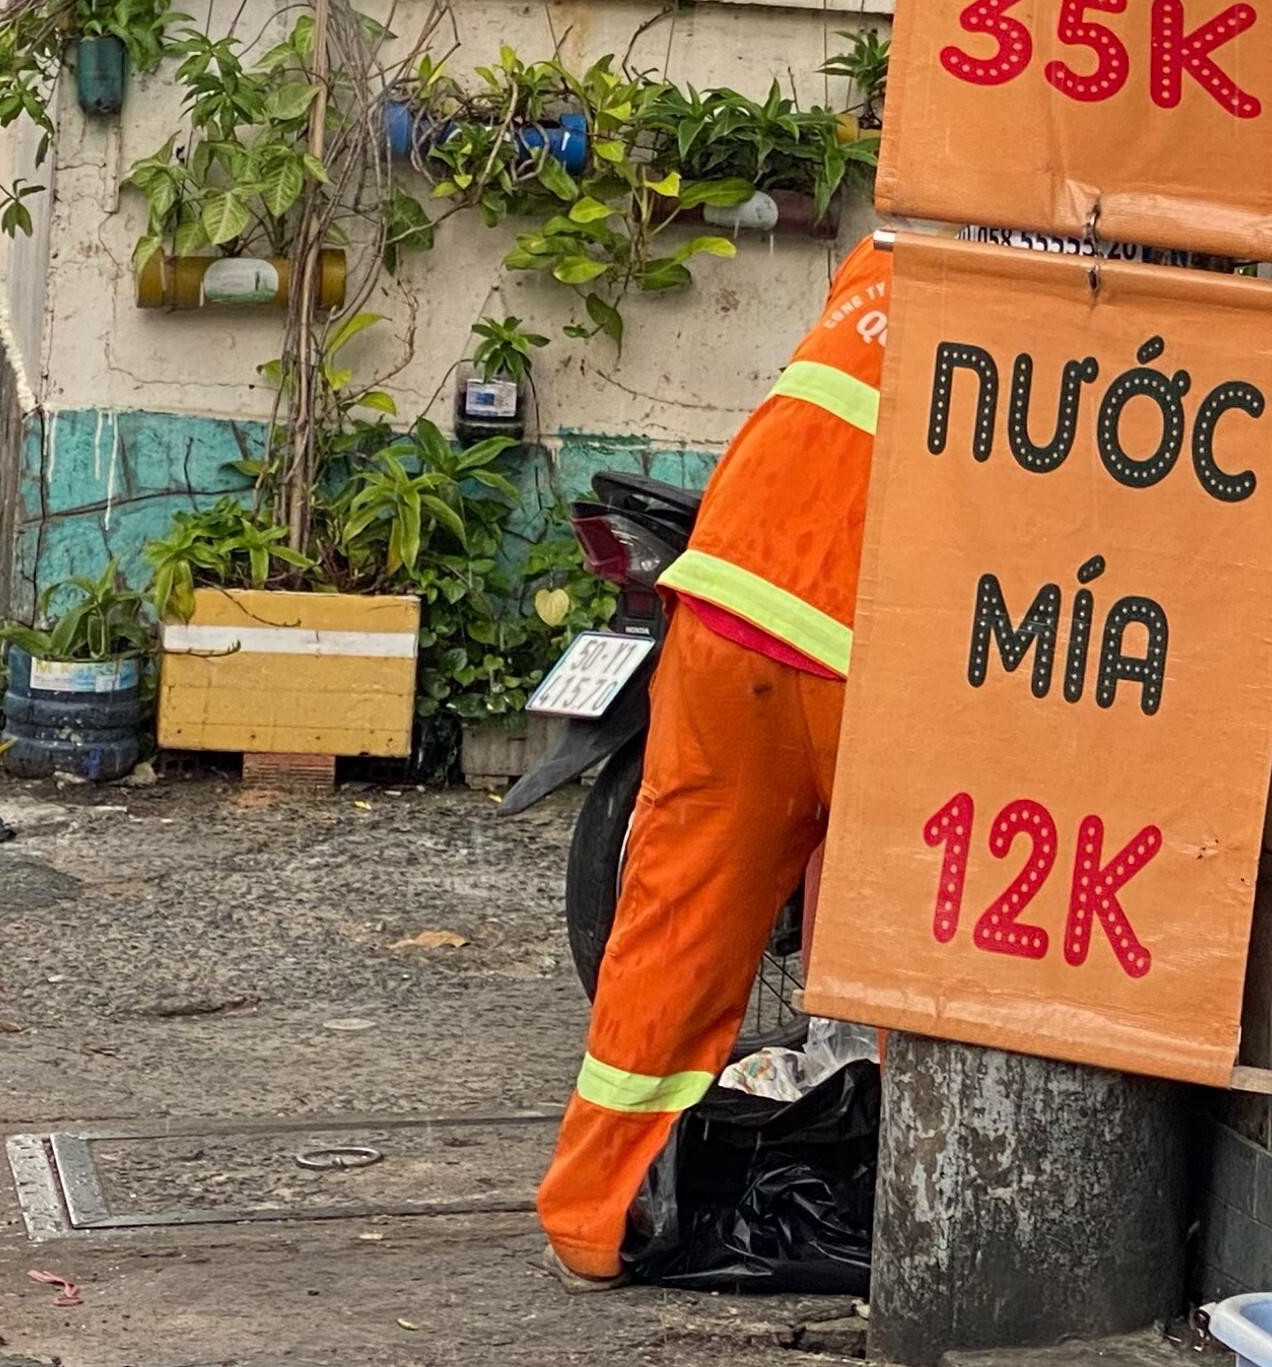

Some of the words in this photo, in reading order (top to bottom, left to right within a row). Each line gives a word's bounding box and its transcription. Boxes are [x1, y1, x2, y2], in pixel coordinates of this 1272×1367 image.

[865, 281, 886, 301] TY
[928, 335, 1266, 502] NƯỚC
[968, 555, 1170, 716] MÍA
[922, 791, 1162, 979] 12K
